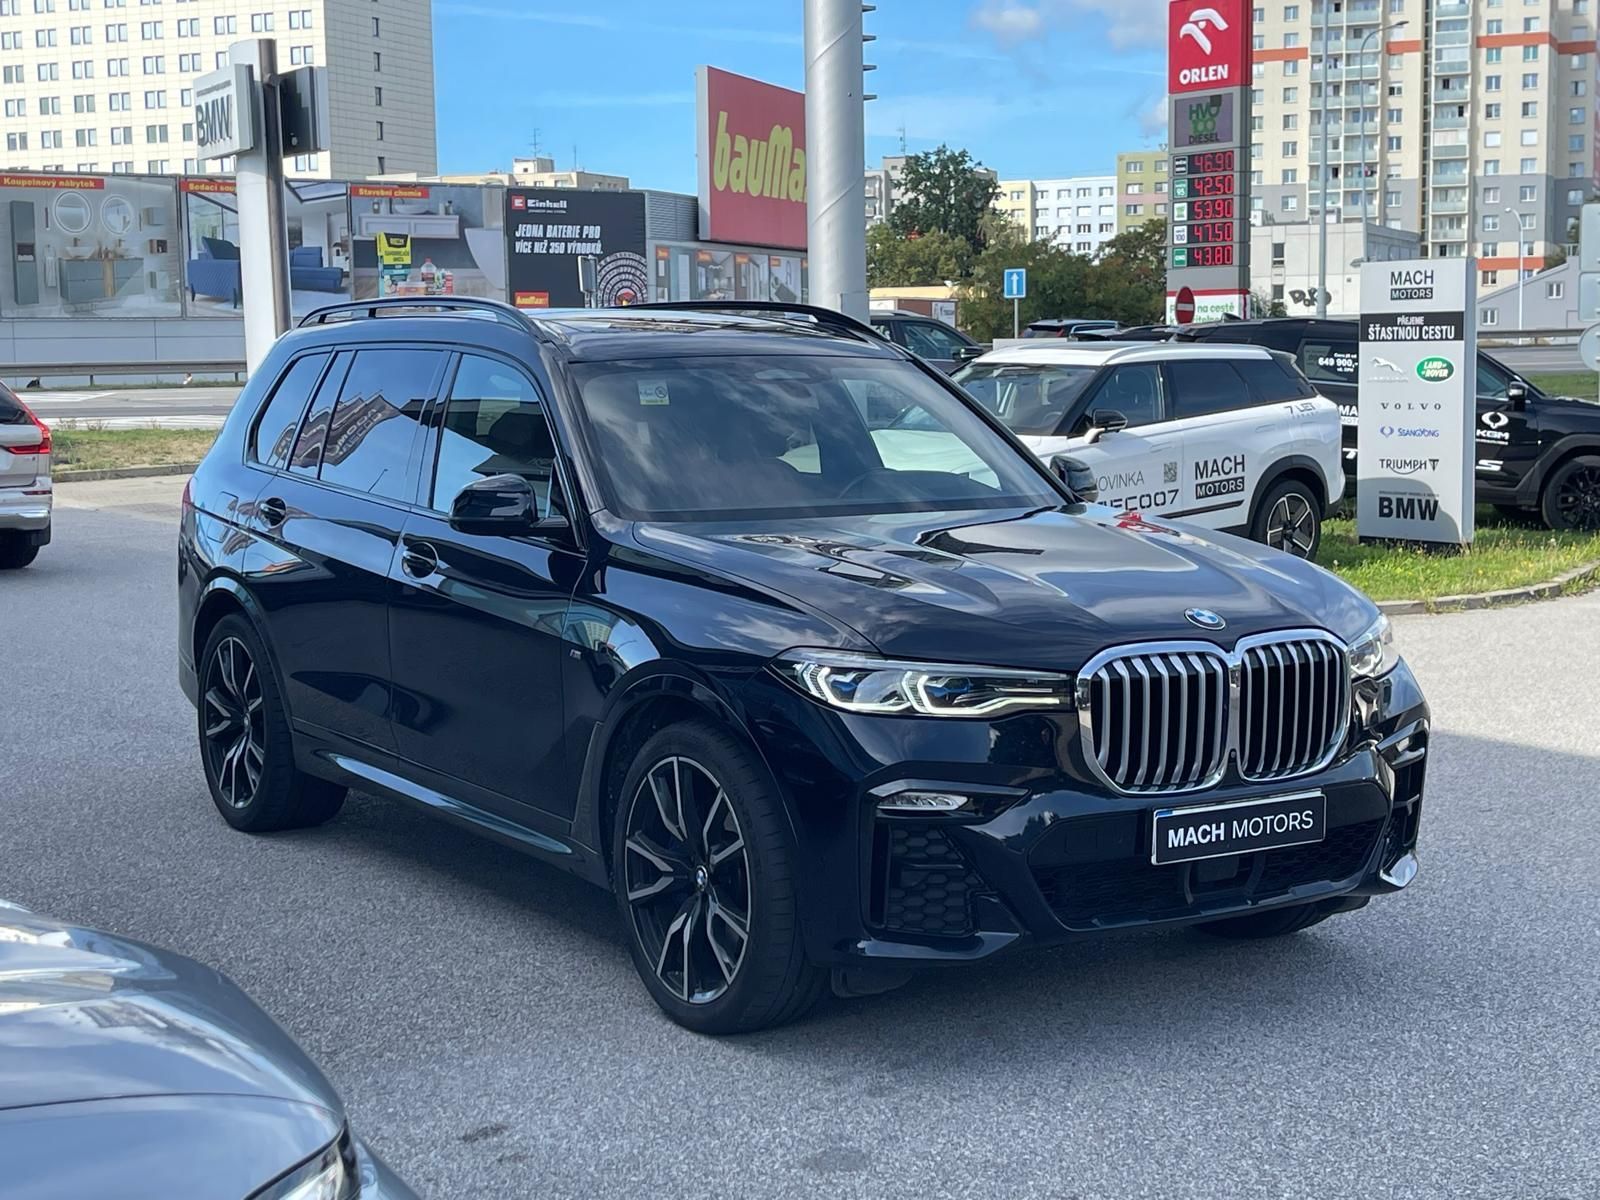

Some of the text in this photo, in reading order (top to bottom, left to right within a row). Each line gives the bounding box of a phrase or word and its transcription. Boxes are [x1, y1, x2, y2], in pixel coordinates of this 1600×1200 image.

[1179, 64, 1228, 85] ORLEN
[195, 94, 232, 147] BMW
[1188, 133, 1220, 145] DIESEL
[713, 110, 807, 203] bauMa
[58, 180, 95, 188] nábytek
[1194, 175, 1233, 196] 42.50
[527, 199, 567, 208] Einhell
[1194, 199, 1233, 220] 53.90
[515, 223, 601, 239] JEDNA BATERIE PRO
[1194, 222, 1233, 243] 47.50
[515, 239, 532, 254] VÍCE
[533, 239, 548, 254] NEŽ
[549, 242, 565, 254] 350
[1390, 269, 1434, 286] MACH
[1391, 288, 1433, 299] MOTORS
[1197, 305, 1209, 313] na
[1397, 315, 1425, 326] PŘEJEME
[1368, 324, 1455, 341] ŠŤASTNOU CESTU
[1318, 357, 1335, 366] 649
[1423, 360, 1443, 369] LAND
[1424, 369, 1449, 378] ROVER
[1380, 402, 1442, 411] VOLVO
[1194, 454, 1245, 480] MACH
[1379, 458, 1427, 470] TRIUMPH
[1096, 470, 1145, 492] OVINKA
[1196, 479, 1244, 497] MOTORS
[1379, 496, 1439, 521] BMW
[1168, 810, 1314, 848] MACH MOTORS
